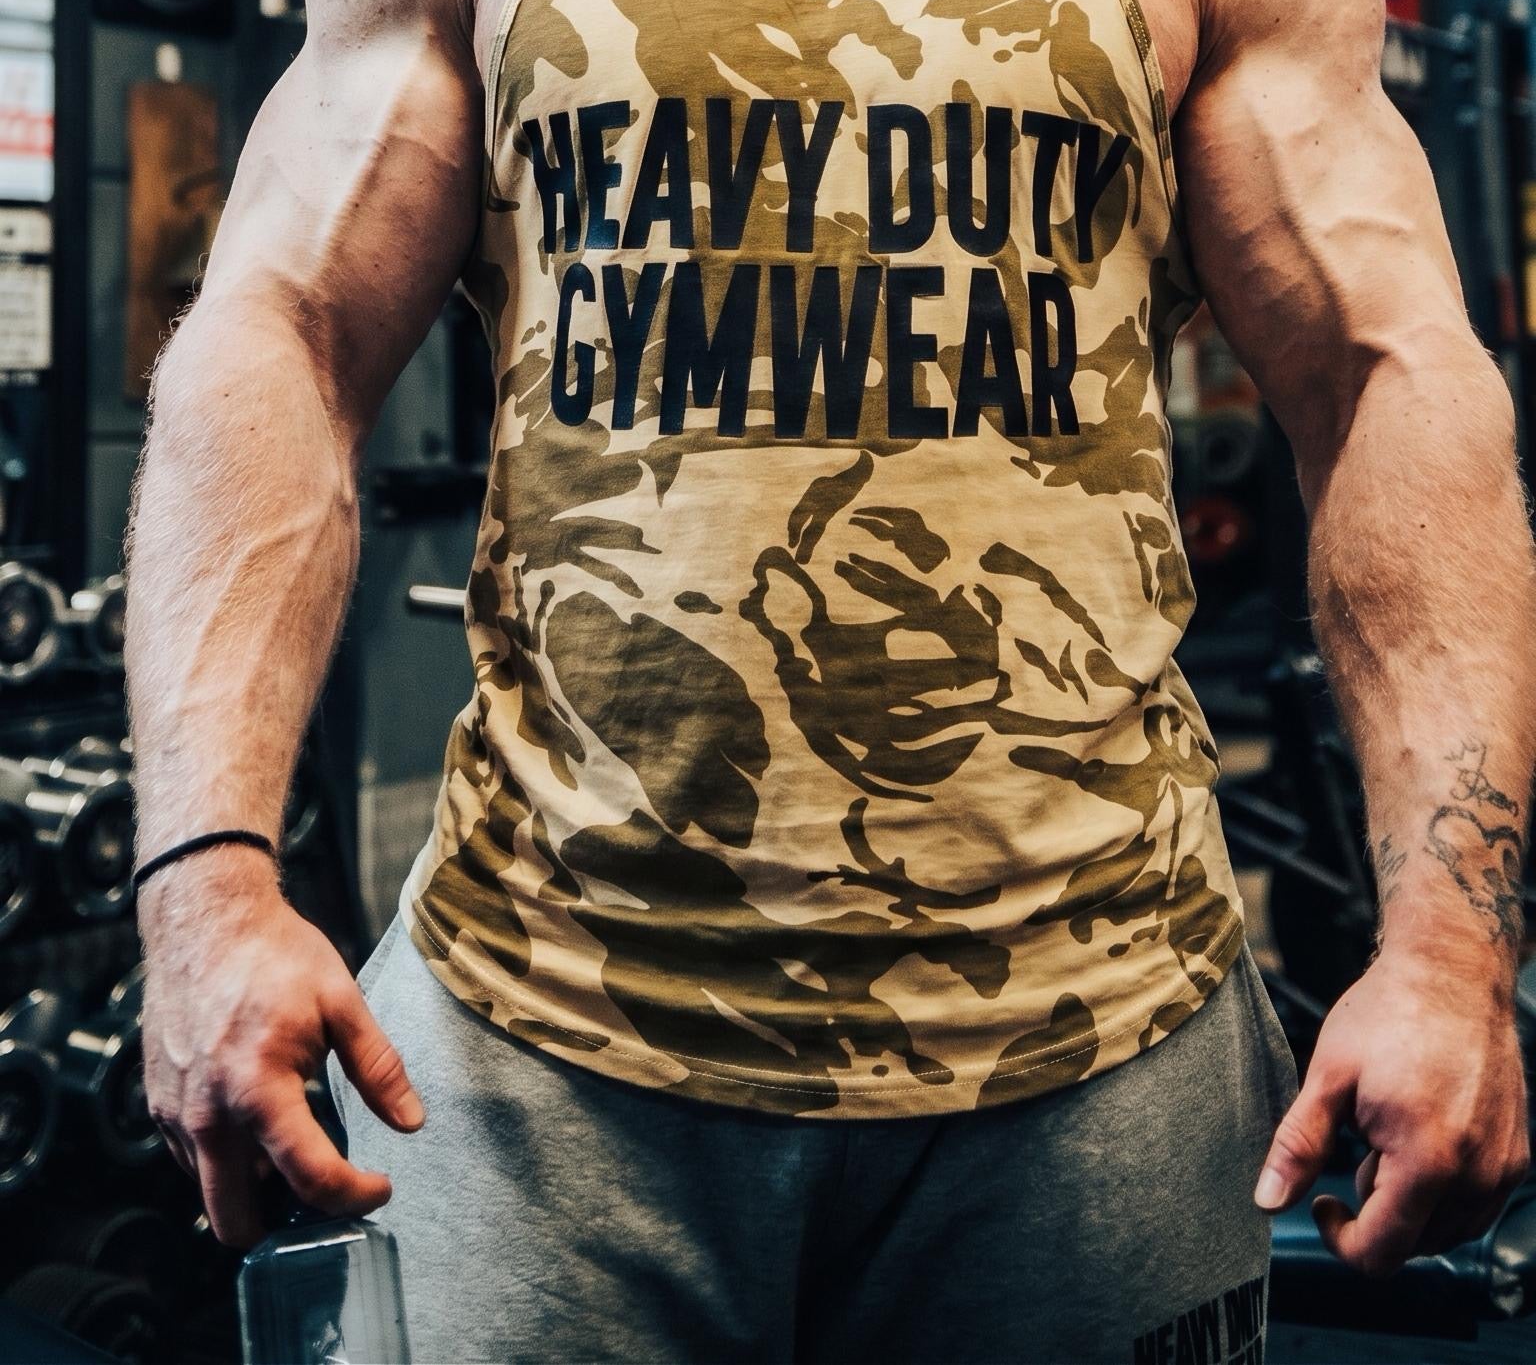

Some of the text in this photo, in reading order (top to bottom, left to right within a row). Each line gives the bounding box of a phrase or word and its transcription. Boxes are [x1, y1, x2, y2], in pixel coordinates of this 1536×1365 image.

[522, 97, 1132, 263] HEAVY DUTY
[551, 262, 1081, 440] GYMWEAR
